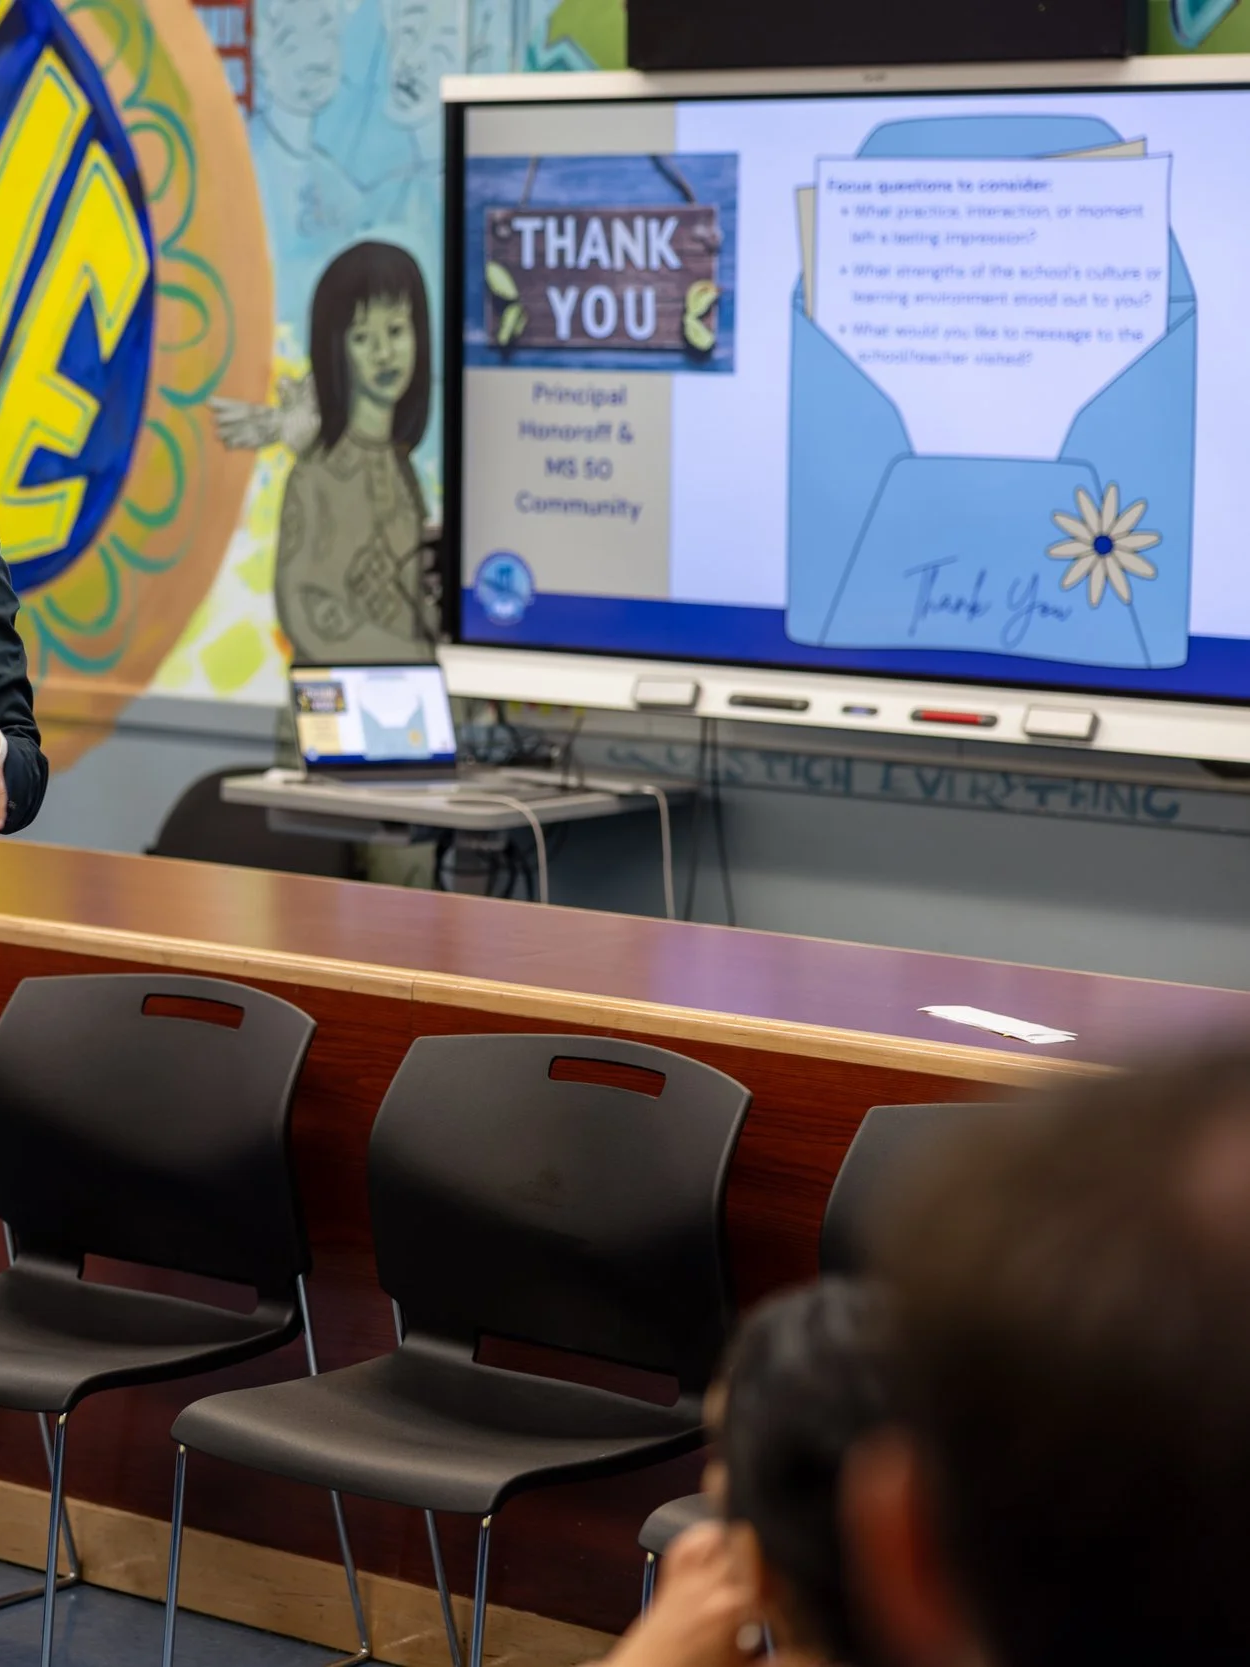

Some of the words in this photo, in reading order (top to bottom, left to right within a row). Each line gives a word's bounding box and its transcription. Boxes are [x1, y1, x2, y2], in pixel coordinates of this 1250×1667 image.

[827, 179, 872, 192] Focus
[878, 180, 953, 195] questions
[957, 180, 974, 192] to
[854, 204, 892, 217] What
[1056, 206, 1073, 218] or
[1076, 204, 1145, 218] moment
[511, 214, 683, 272] THANK
[853, 263, 891, 277] What
[897, 263, 966, 282] strengths
[971, 263, 986, 278] of
[989, 265, 1015, 278] the
[1085, 264, 1141, 280] culture
[914, 291, 1008, 306] environment
[1014, 291, 1058, 307] stood
[1063, 294, 1087, 307] out
[1092, 293, 1108, 307] to
[547, 284, 657, 341] YOU
[852, 322, 889, 337] What
[895, 323, 940, 338] would
[943, 327, 969, 342] you
[974, 324, 998, 338] like
[1003, 326, 1019, 340] to
[1097, 327, 1113, 341] to
[1118, 327, 1144, 342] the
[532, 381, 628, 409] Principal
[617, 421, 635, 444] &
[544, 457, 577, 480] MS
[583, 457, 614, 481] 50
[515, 490, 644, 523] Community
[903, 554, 993, 637] Thank
[1000, 570, 1073, 650] You
